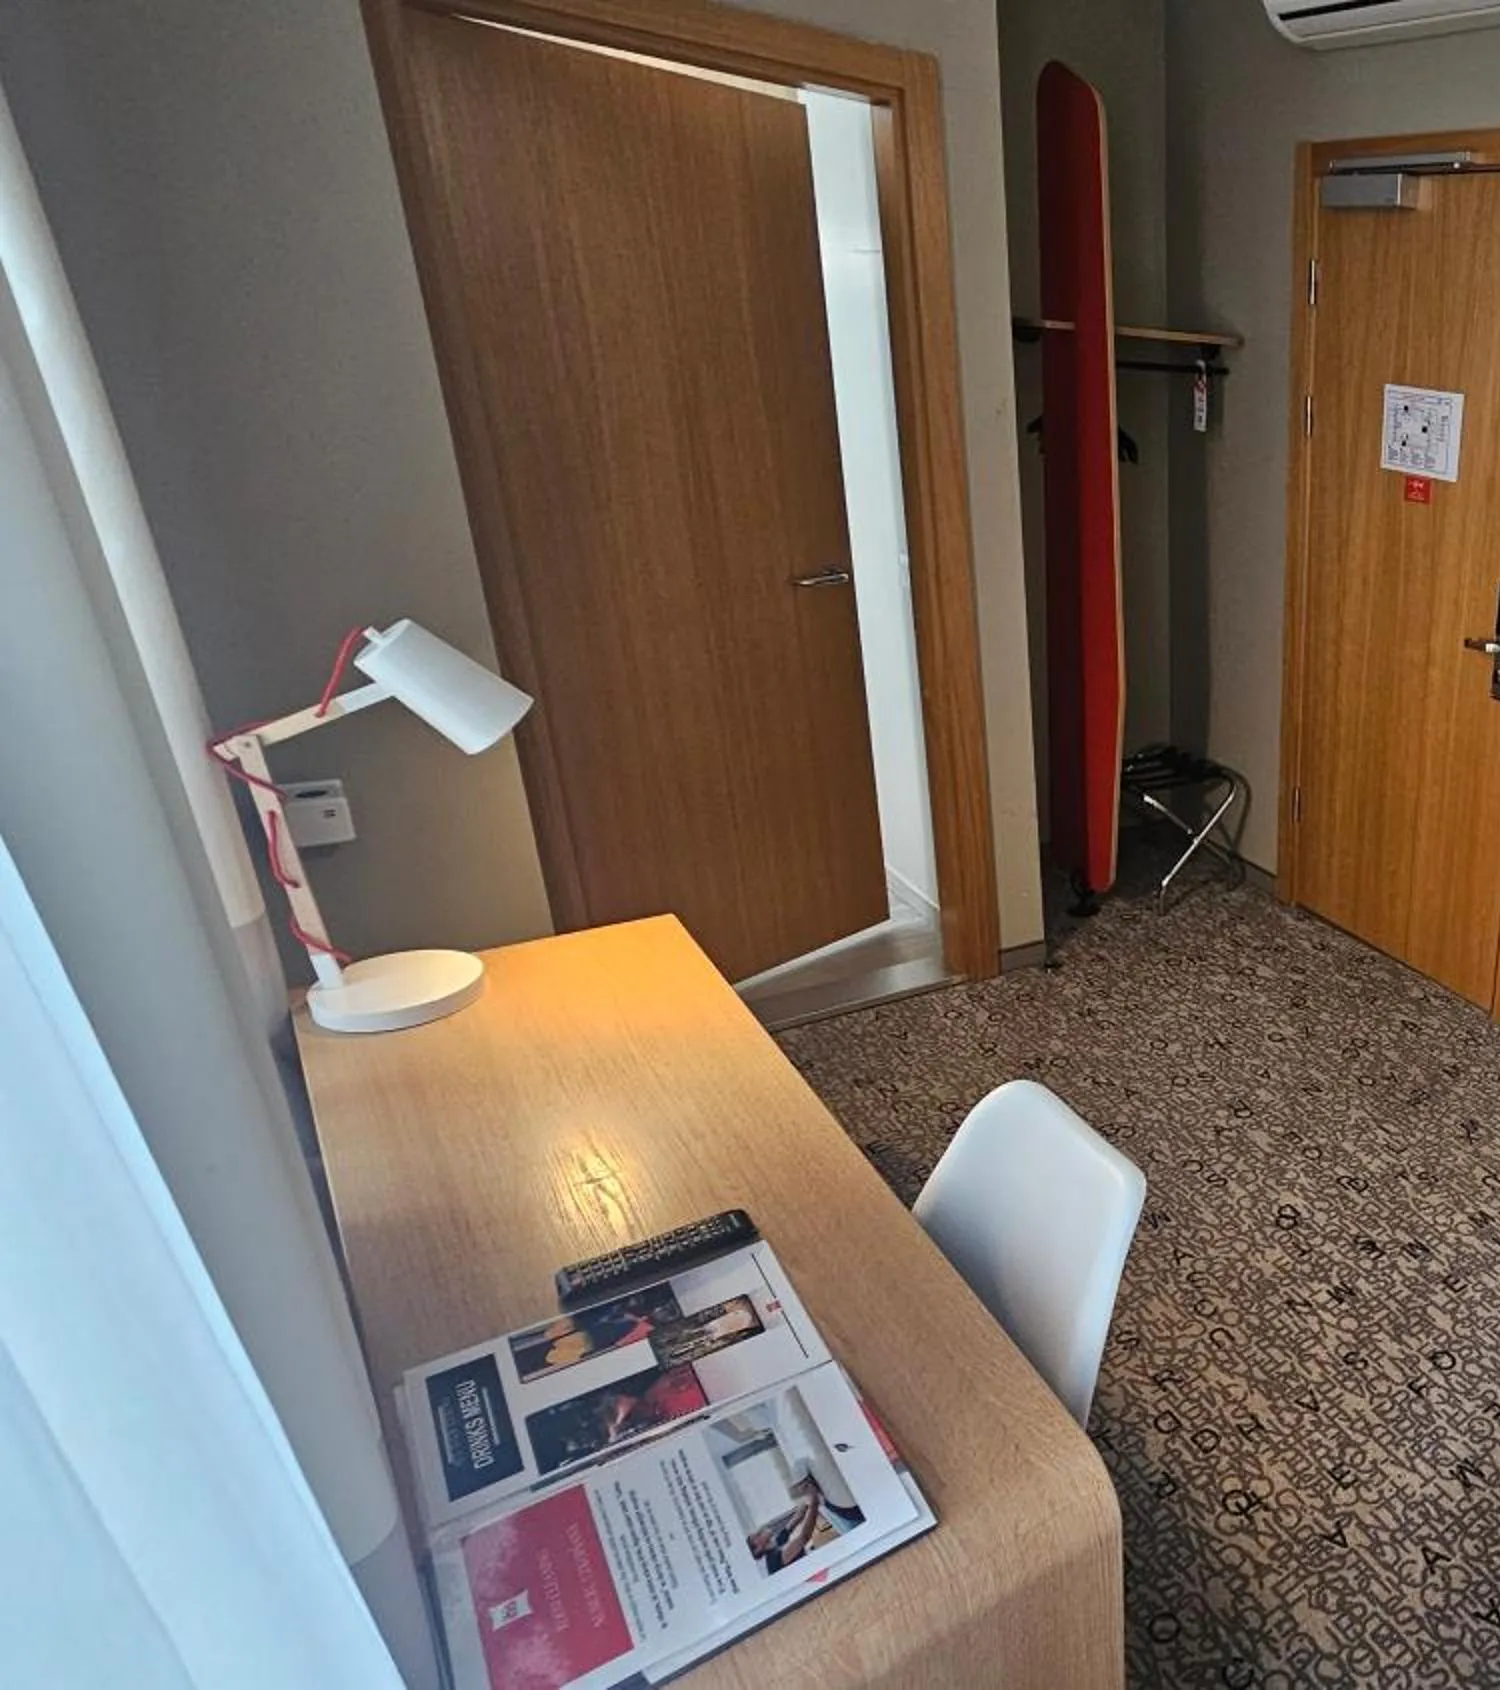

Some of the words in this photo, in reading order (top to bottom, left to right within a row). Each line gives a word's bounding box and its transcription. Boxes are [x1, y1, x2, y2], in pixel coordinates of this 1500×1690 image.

[454, 1377, 482, 1420] MENU
[463, 1415, 495, 1470] DRINKS
[1421, 1546, 1451, 1574] A
